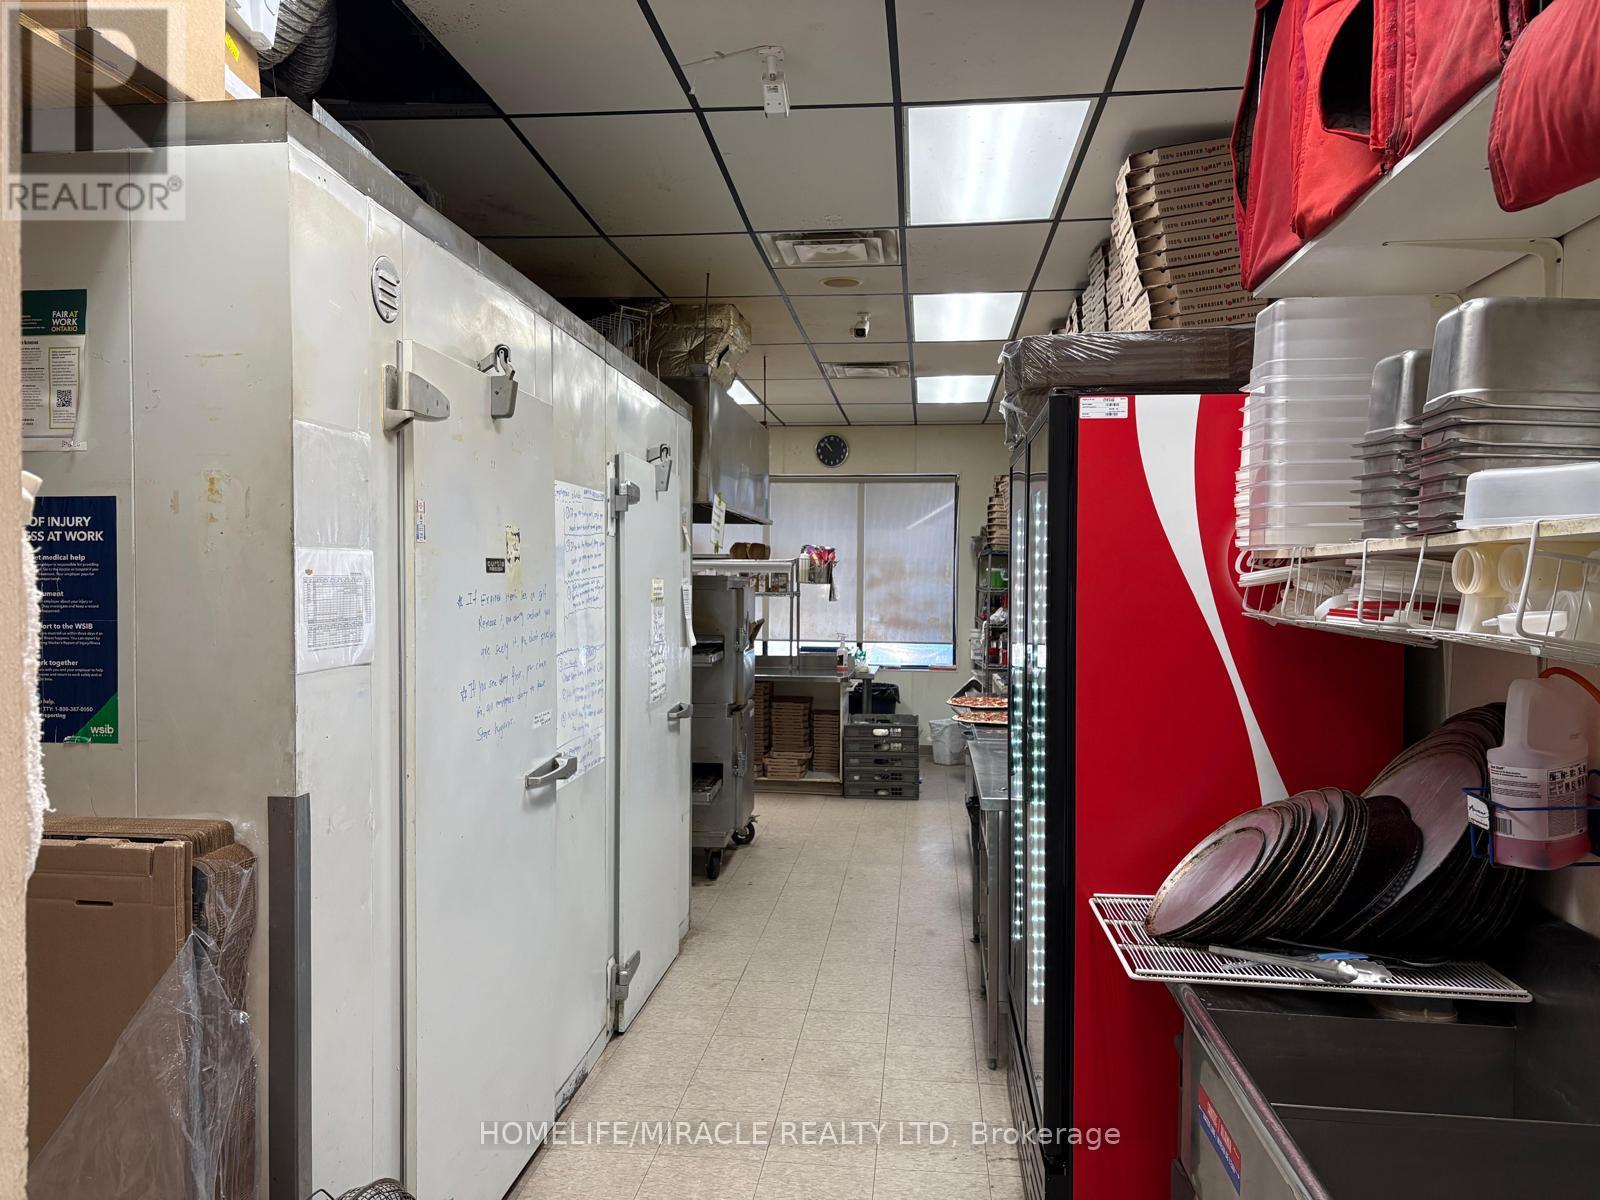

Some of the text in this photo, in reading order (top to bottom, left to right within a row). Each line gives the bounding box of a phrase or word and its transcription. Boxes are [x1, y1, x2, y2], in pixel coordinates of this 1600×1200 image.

[52, 310, 68, 318] FAIR
[52, 318, 78, 326] WORK
[29, 516, 92, 527] OF INJURY
[47, 531, 62, 542] AT
[65, 530, 104, 542] WORK
[70, 554, 86, 562] help
[49, 659, 79, 668] together
[90, 723, 114, 734] wsib
